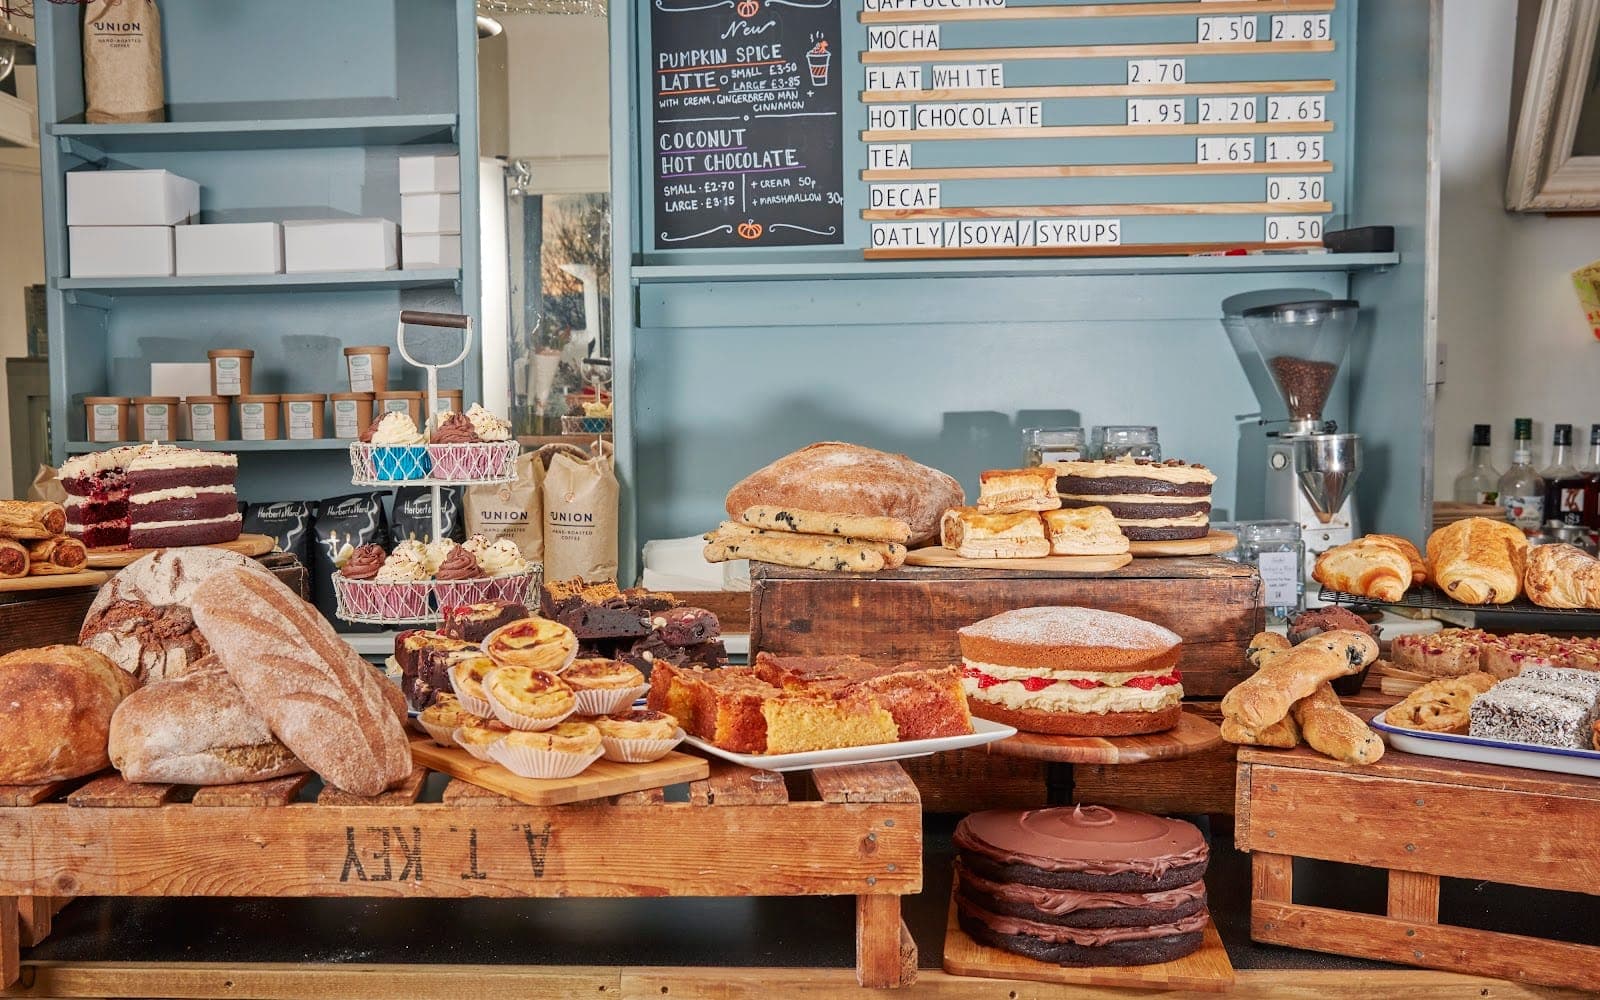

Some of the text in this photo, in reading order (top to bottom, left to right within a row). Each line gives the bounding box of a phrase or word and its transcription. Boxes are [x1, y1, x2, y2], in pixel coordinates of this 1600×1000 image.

[94, 22, 140, 31] UNION
[720, 21, 776, 39] New
[870, 19, 1327, 49] MOCHA 2.50 2.85
[660, 44, 782, 68] PUMPKIN SPICE
[661, 72, 717, 90] LATTE
[731, 68, 762, 78] SMALL
[869, 63, 1183, 89] FLAT WHITE 2.70
[733, 80, 766, 91] LARGE
[660, 98, 679, 107] WITH
[717, 92, 775, 104] GINGERBREAD
[778, 91, 798, 100] MAN
[753, 101, 805, 112] CINNAMON
[871, 101, 1321, 128] HOT CHOCOLATE 1.95 2.20 2.65
[660, 129, 746, 150] COCONUT
[661, 149, 799, 174] HOT CHOCOLATE
[871, 141, 1321, 167] TEA 1.65 1.95
[664, 184, 696, 197] SMALL
[760, 178, 790, 188] CREAM
[798, 176, 816, 189] 50p
[759, 193, 821, 205] MARSHMALLOW
[872, 181, 1321, 207] DECAF 0.30
[665, 200, 698, 212] LARGE
[1269, 221, 1321, 240] 0.50
[481, 511, 528, 520] UNION
[550, 511, 592, 522] UNION
[339, 826, 423, 882] KEY
